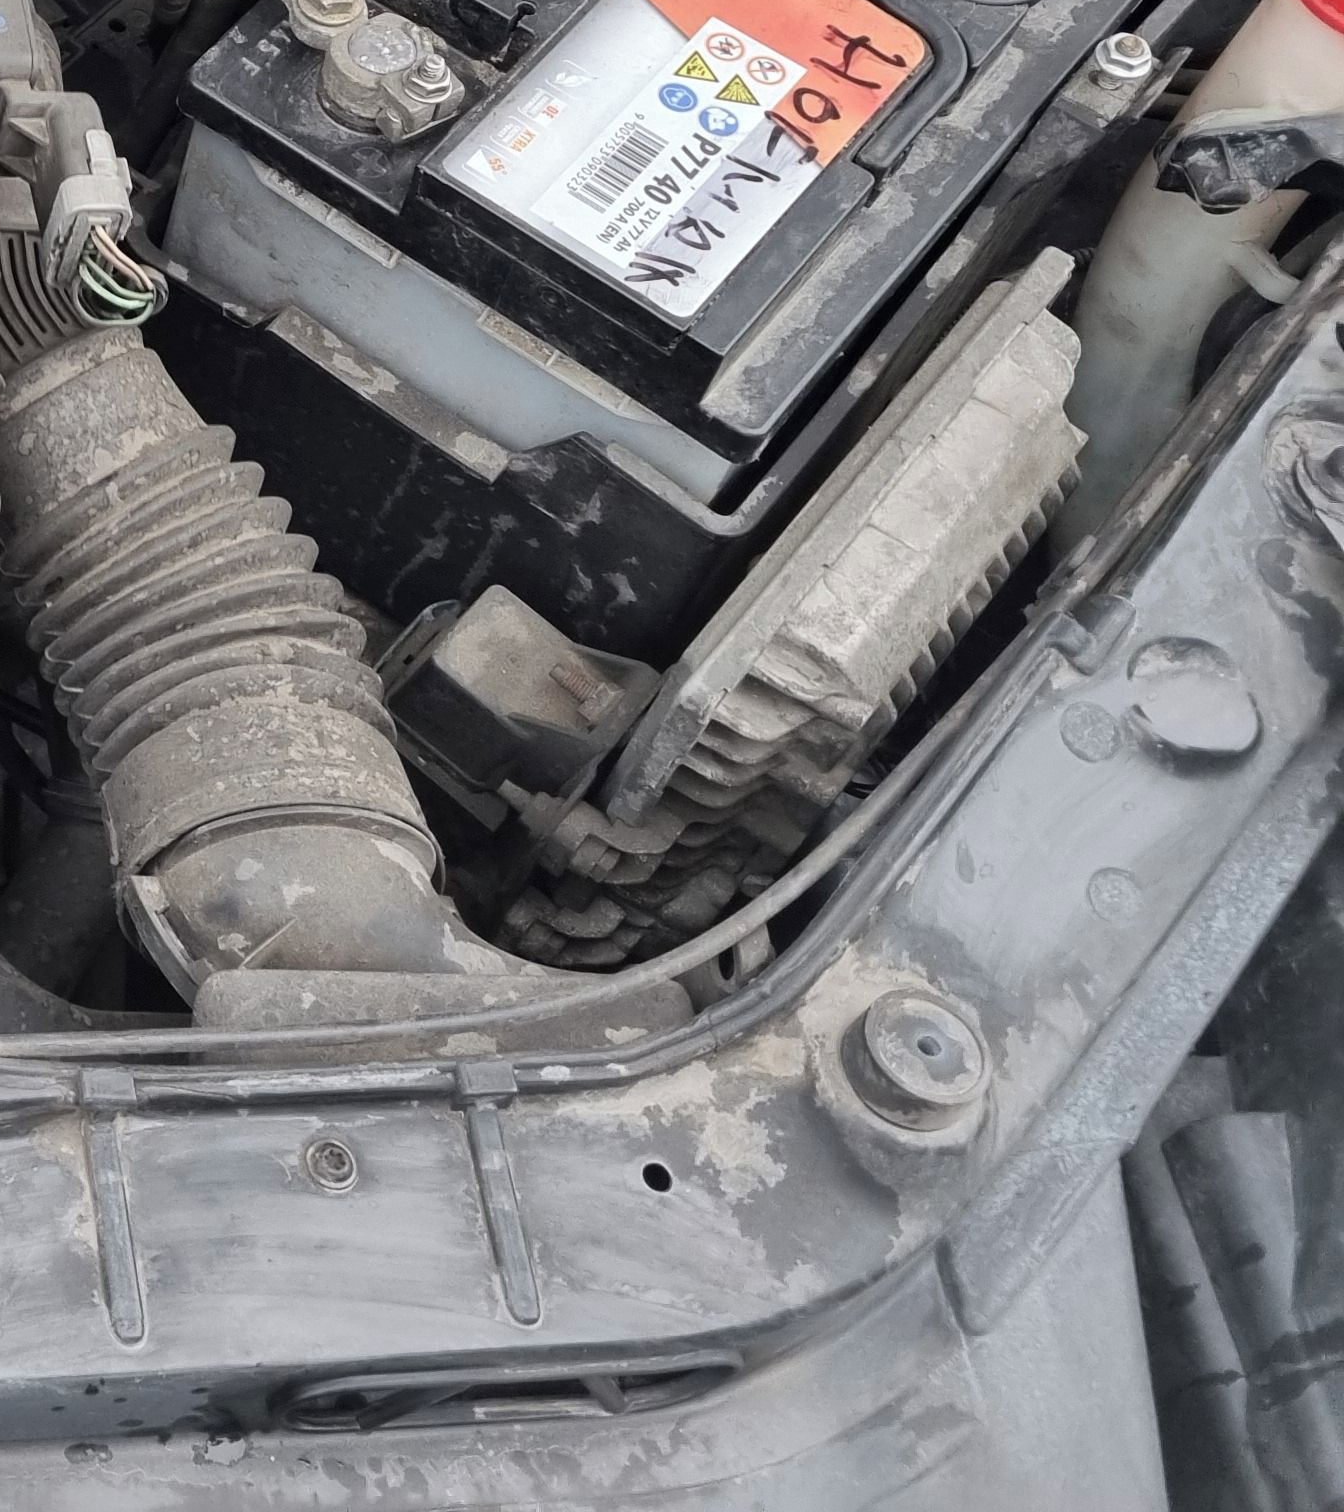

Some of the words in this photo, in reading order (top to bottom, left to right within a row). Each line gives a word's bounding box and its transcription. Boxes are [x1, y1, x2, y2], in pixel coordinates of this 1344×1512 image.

[510, 129, 536, 153] XTRA
[598, 121, 634, 157] 005753
[670, 132, 722, 181] P77
[565, 156, 602, 193] 090323
[643, 173, 682, 205] 40
[621, 195, 644, 218] 700
[597, 221, 622, 244] (EN)
